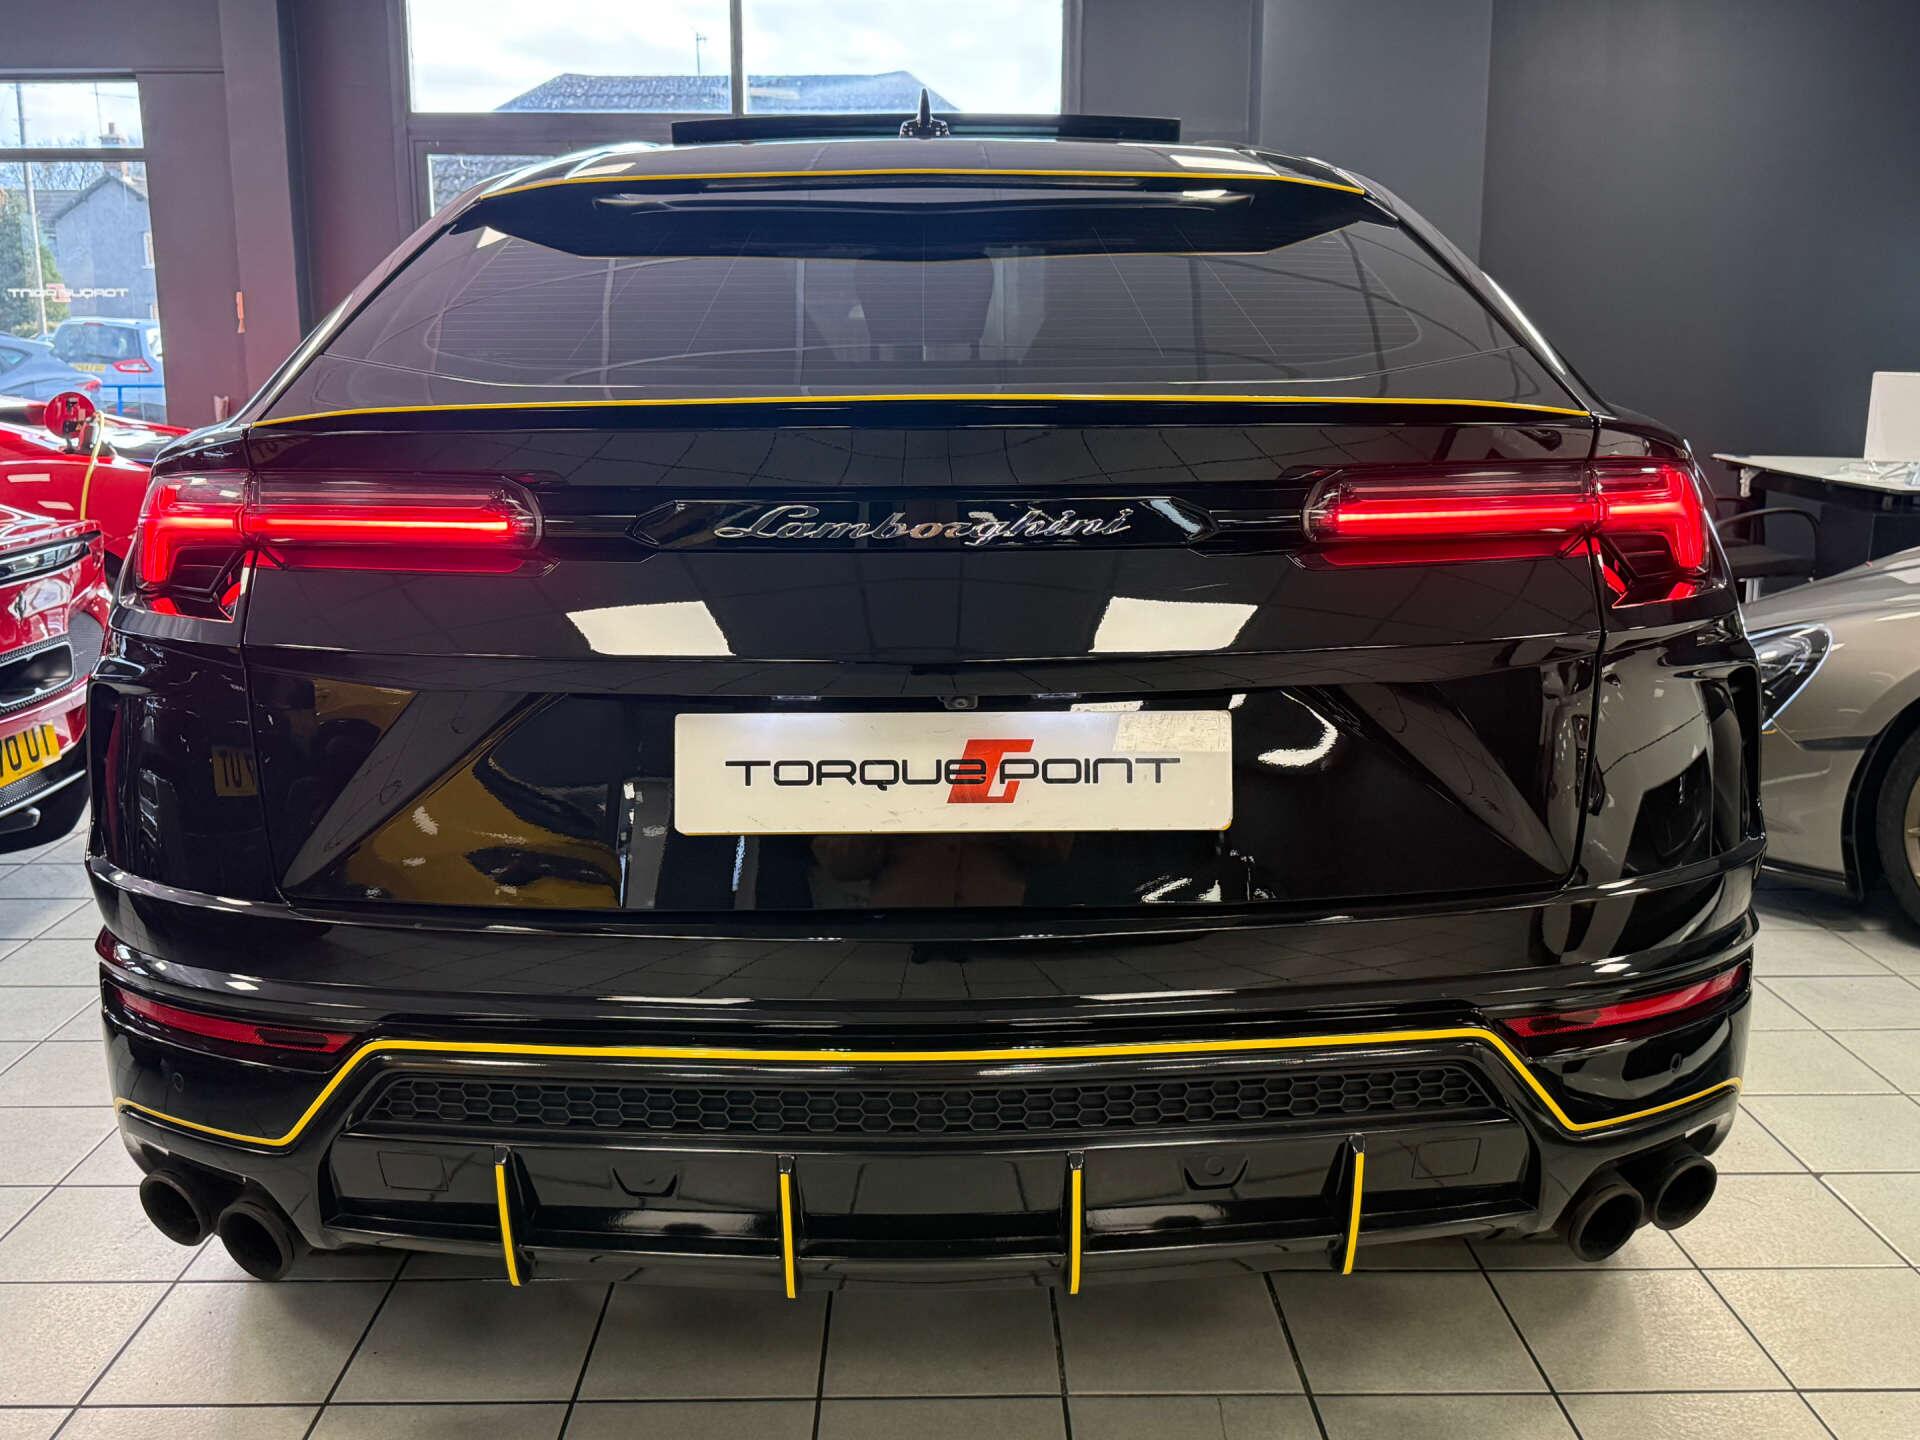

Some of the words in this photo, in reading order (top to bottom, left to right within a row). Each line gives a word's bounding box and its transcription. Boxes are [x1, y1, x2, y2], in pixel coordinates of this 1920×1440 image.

[713, 504, 1132, 546] Lamborghini
[725, 758, 987, 791] TORQUE
[999, 757, 1181, 785] POINT
